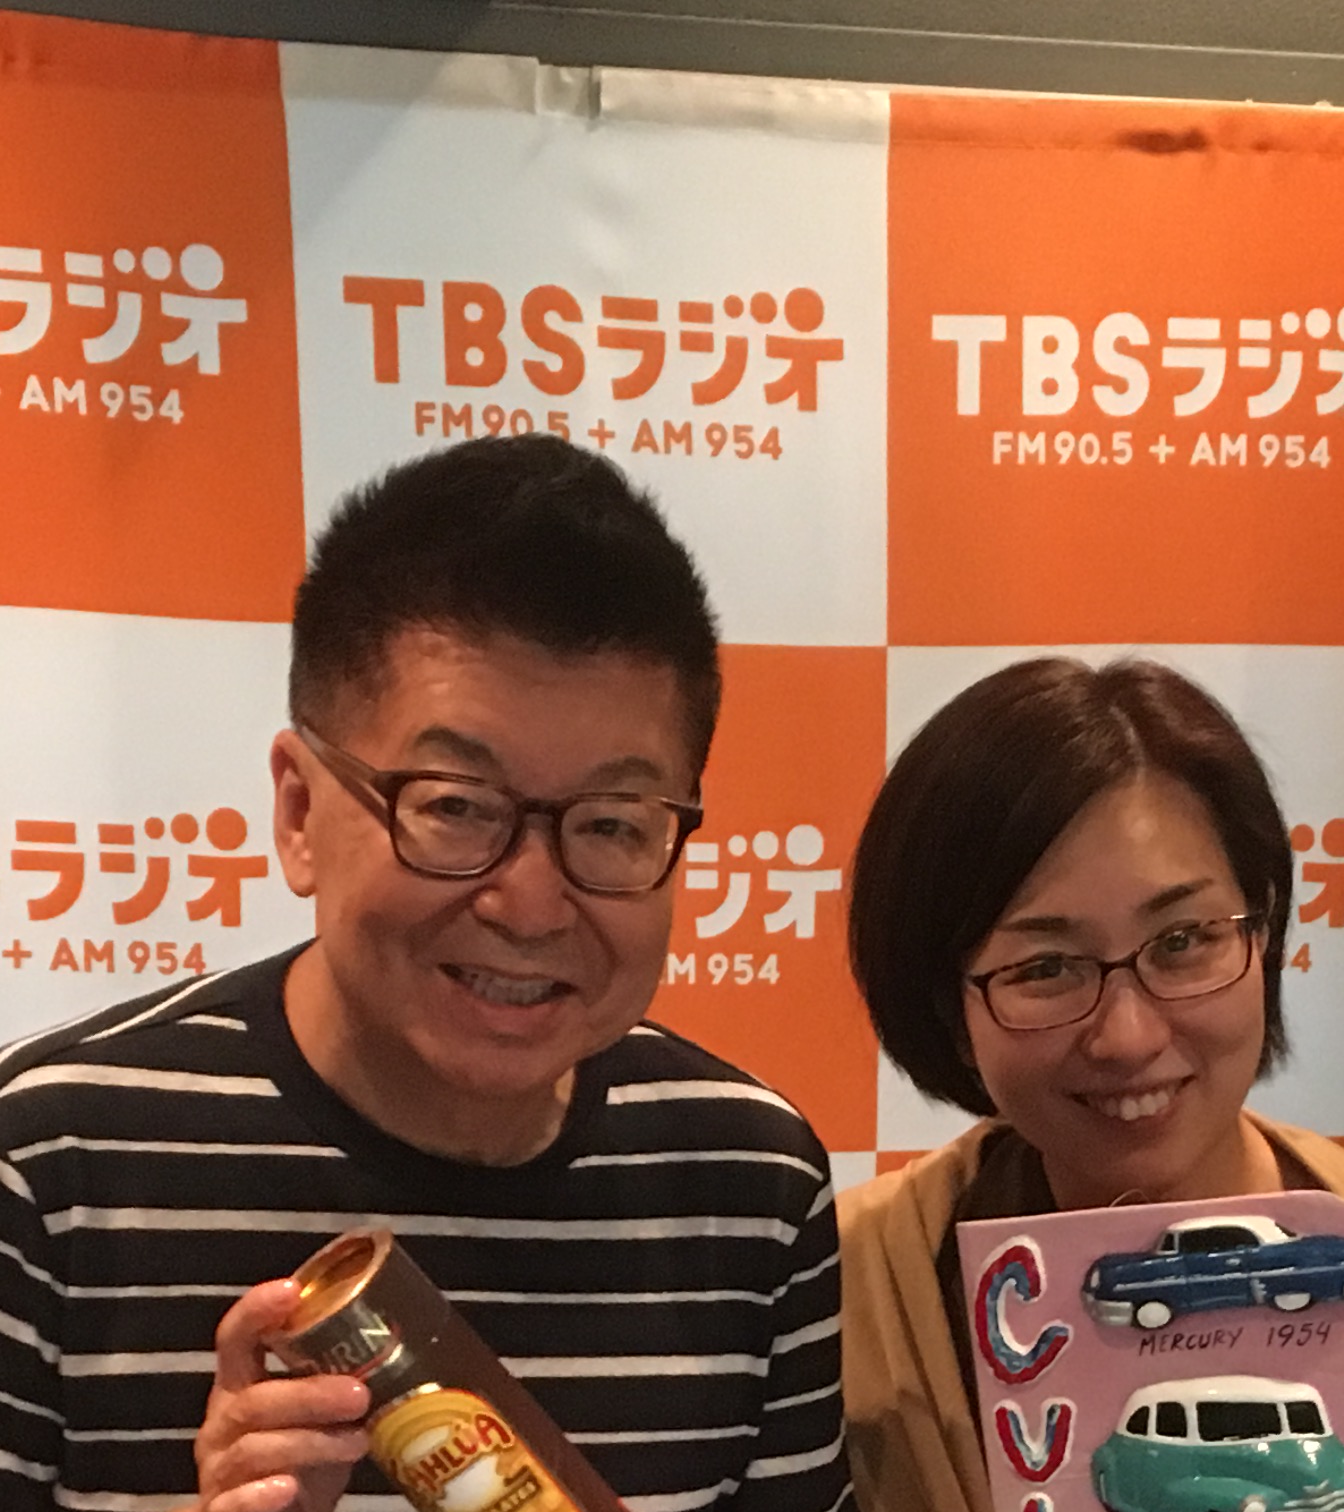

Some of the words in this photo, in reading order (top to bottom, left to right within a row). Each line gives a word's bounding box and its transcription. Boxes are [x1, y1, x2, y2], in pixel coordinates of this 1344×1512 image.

[343, 275, 844, 411] TBSラジオ
[1139, 1326, 1244, 1356] MERCURY
[1266, 1321, 1332, 1347] 1954
